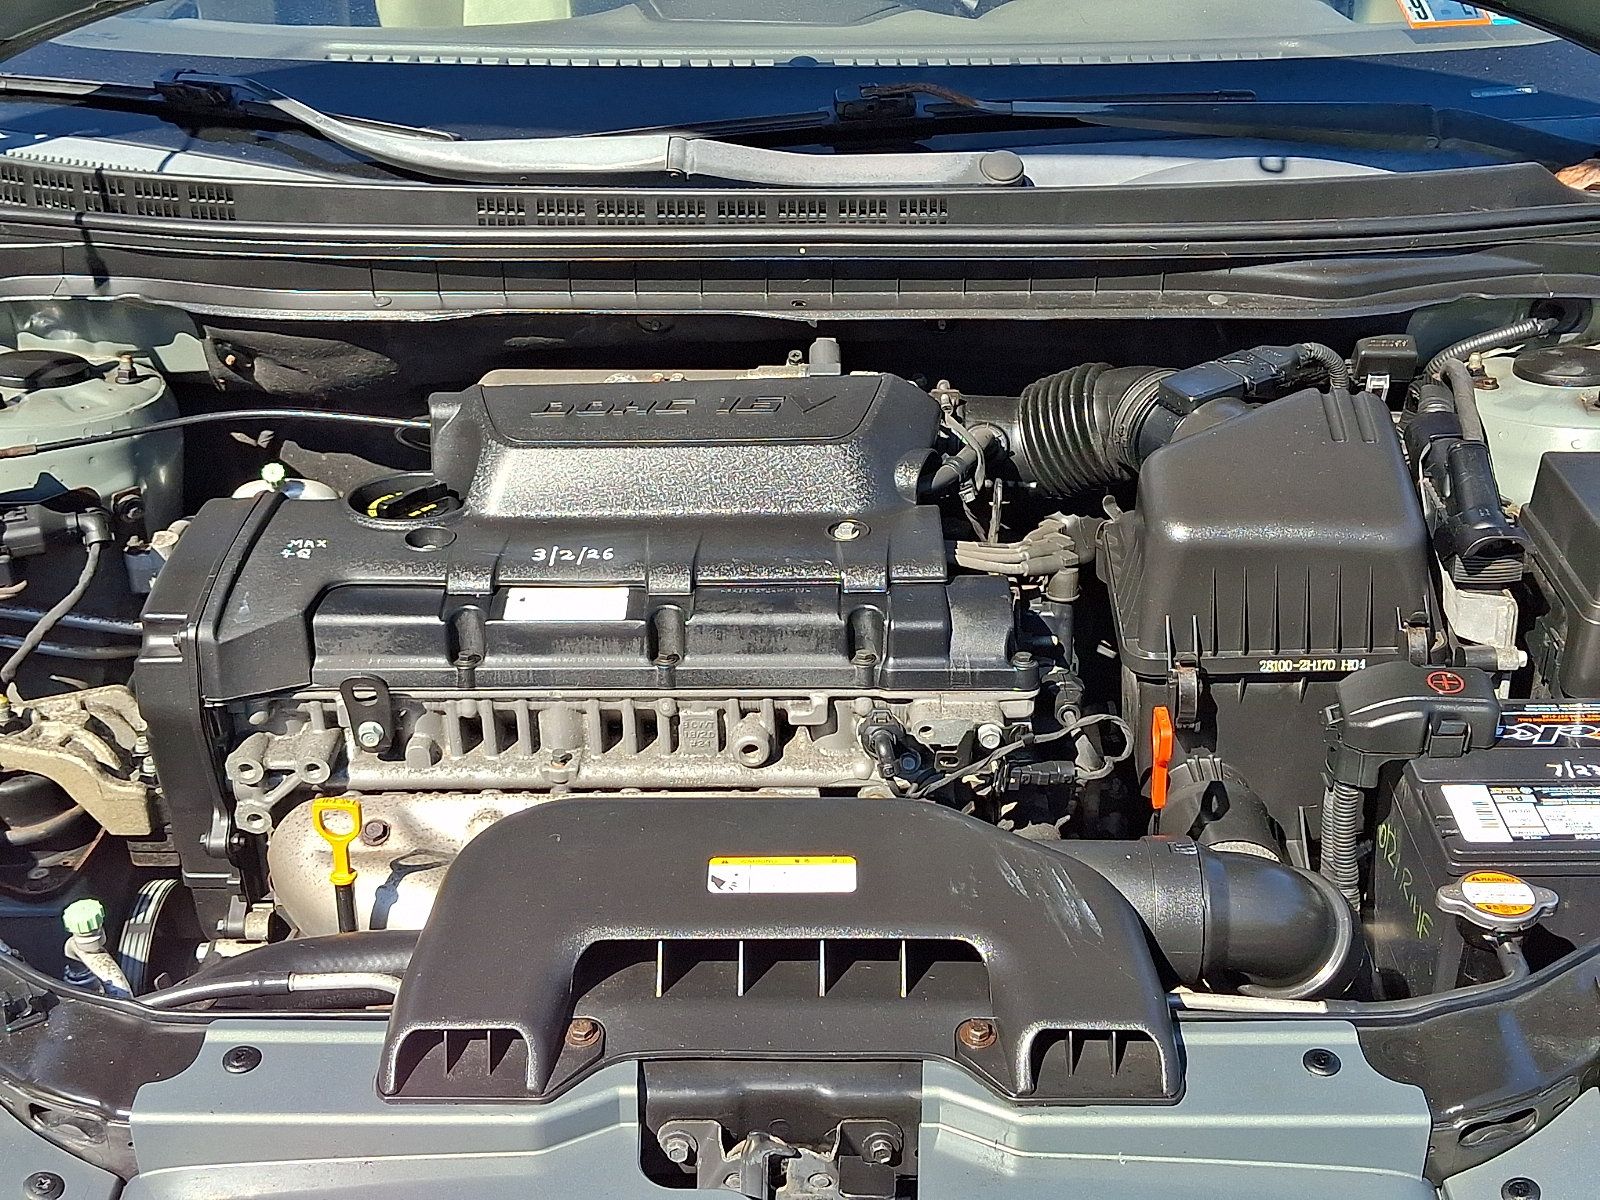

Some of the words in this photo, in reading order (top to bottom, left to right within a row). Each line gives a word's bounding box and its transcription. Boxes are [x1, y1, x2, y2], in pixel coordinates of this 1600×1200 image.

[530, 399, 697, 417] DOHC
[286, 538, 327, 549] MAX
[531, 547, 615, 566] 3/2/26
